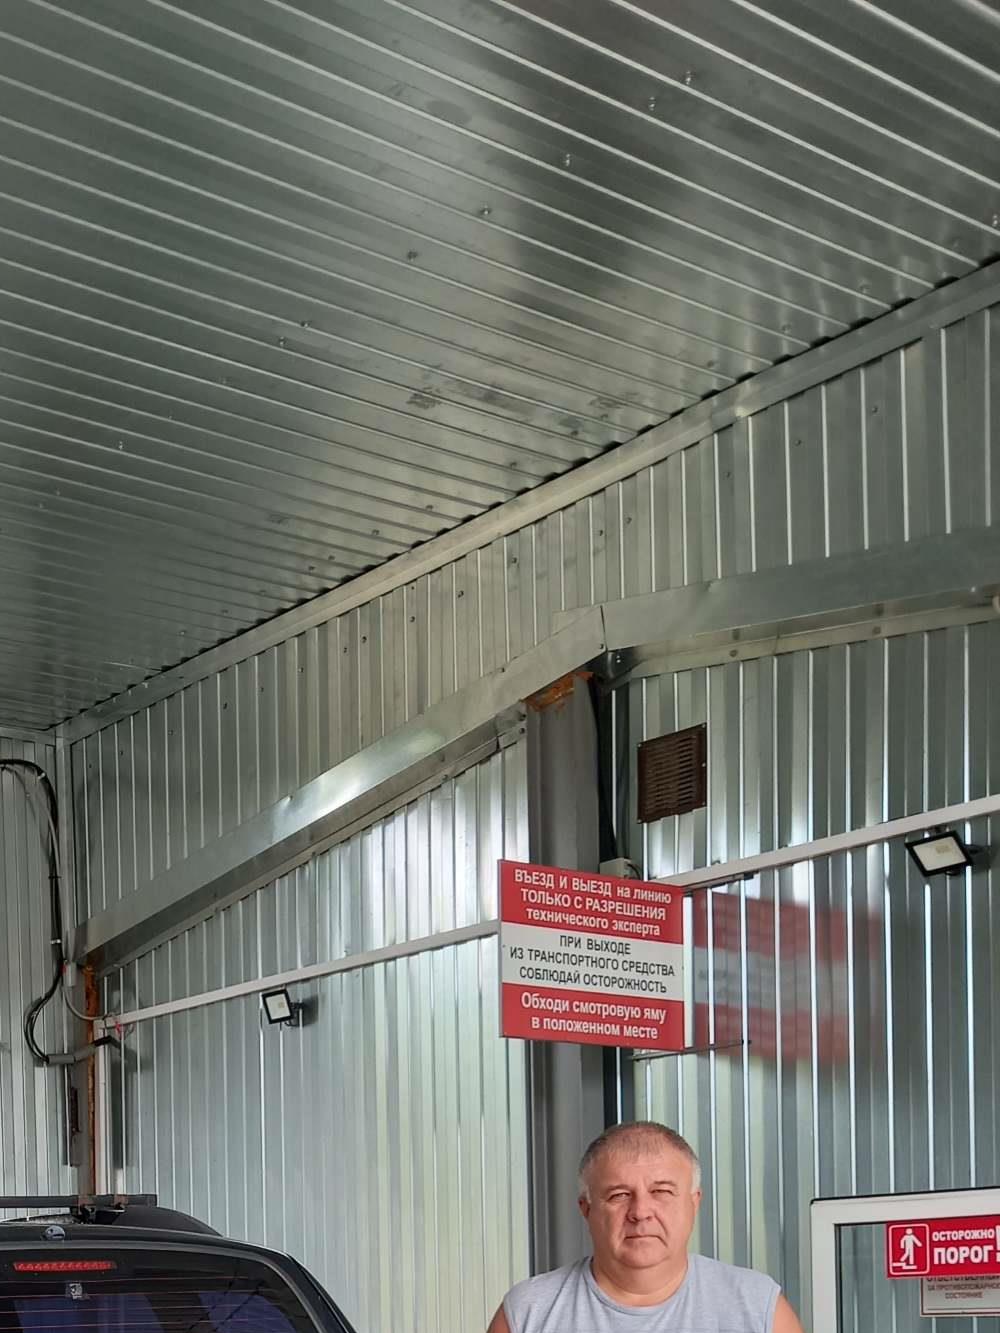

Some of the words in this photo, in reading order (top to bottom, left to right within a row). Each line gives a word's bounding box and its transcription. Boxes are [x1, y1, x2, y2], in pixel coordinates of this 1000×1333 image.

[515, 869, 555, 888] ВЪЕЗД
[560, 876, 567, 888] И
[572, 876, 611, 897] ВЫЕЗД
[617, 886, 631, 898] на
[633, 888, 671, 904] линию
[521, 888, 571, 908] ТОЛЬКО
[574, 896, 582, 908] С
[586, 897, 666, 920] РАЗРЕШЕНИЯ
[527, 908, 608, 929] технического
[612, 919, 660, 937] эксперта
[560, 935, 581, 949] ПРИ
[587, 938, 631, 955] ВЫХОДЕ
[510, 947, 523, 959] ИЗ
[528, 949, 618, 971] ТРАНСПОРТНОГО
[622, 960, 674, 976] СРЕДСТВА
[520, 966, 580, 984] СОБЛЮДАЙ
[583, 975, 667, 993] ОСТОРОЖНОСТЬ
[521, 991, 569, 1012] Обходи
[573, 1001, 641, 1019] смотровую
[644, 1006, 666, 1024] яму
[532, 1018, 539, 1029] в
[544, 1019, 620, 1035] положенном
[624, 1025, 658, 1039] месте
[932, 1228, 995, 1242] ОСТОРОЖНО
